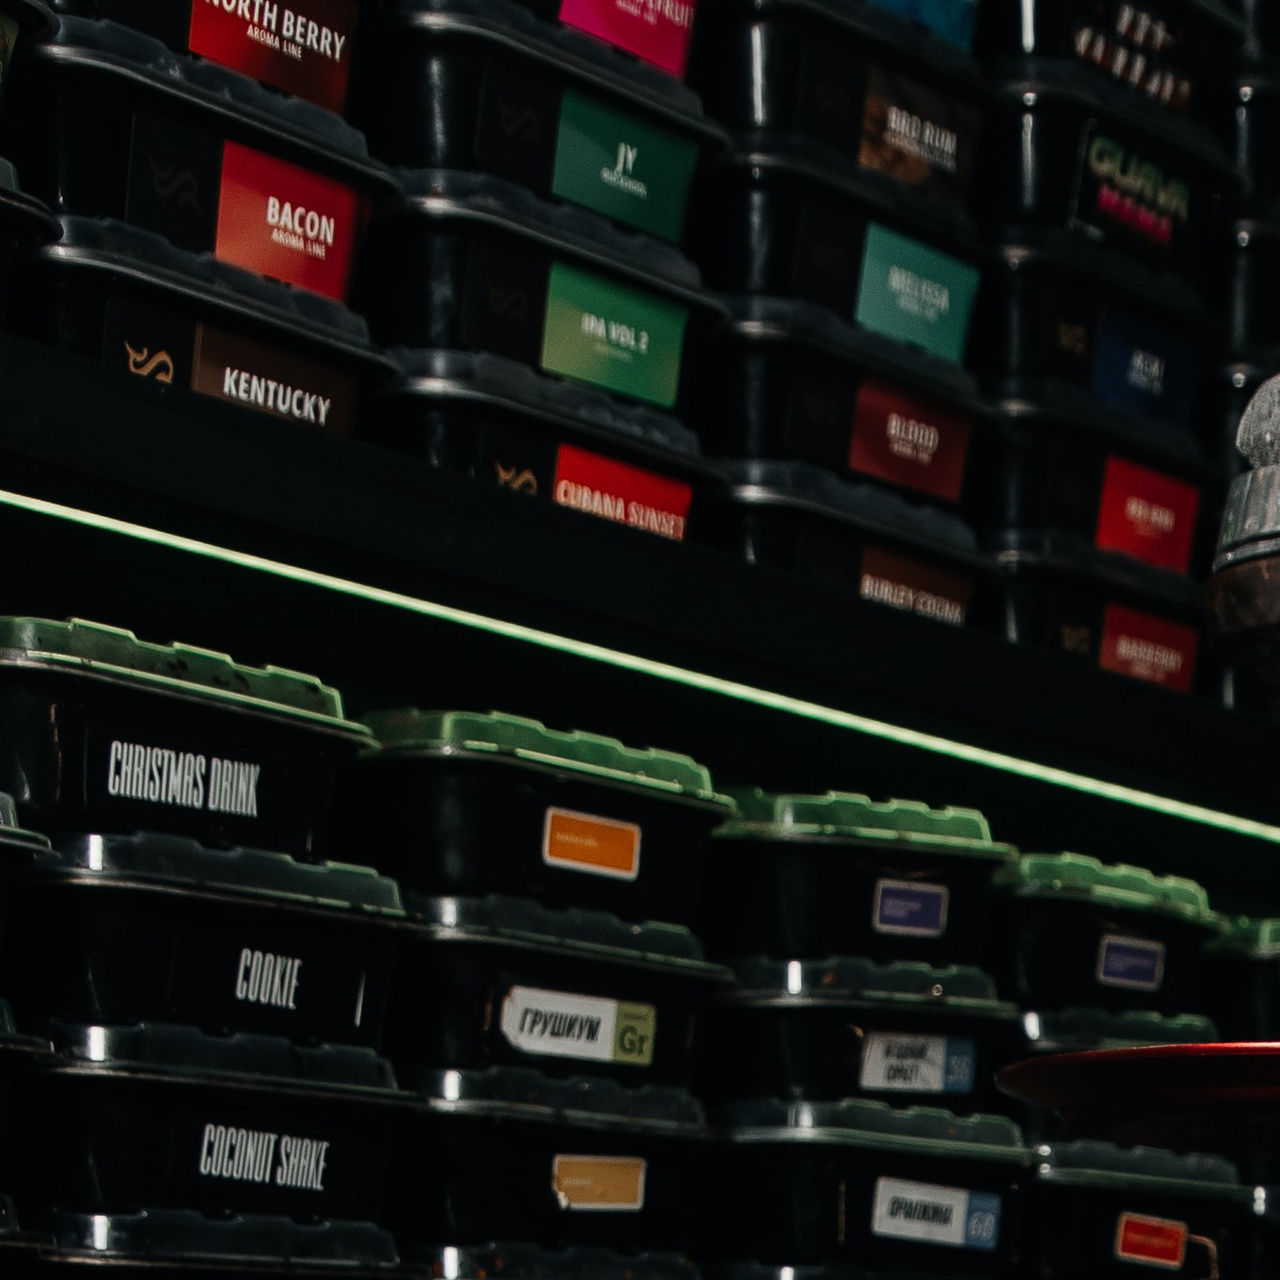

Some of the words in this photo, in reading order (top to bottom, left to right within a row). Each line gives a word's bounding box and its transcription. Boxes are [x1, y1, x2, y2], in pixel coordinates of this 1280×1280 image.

[203, 0, 279, 33] RTH
[281, 8, 346, 63] BERRY
[246, 23, 280, 51] AROMA
[282, 39, 303, 62] LINE
[266, 195, 335, 248] BACON
[271, 227, 305, 252] AROMA
[223, 365, 331, 427] KENTUCKY
[556, 479, 627, 525] CUBANA
[107, 739, 207, 810] CHRISTMAS
[207, 756, 261, 819] DRINK
[234, 946, 302, 1011] COOKIE
[199, 1122, 278, 1185] COCONUT
[276, 1132, 330, 1192] SHAKE
